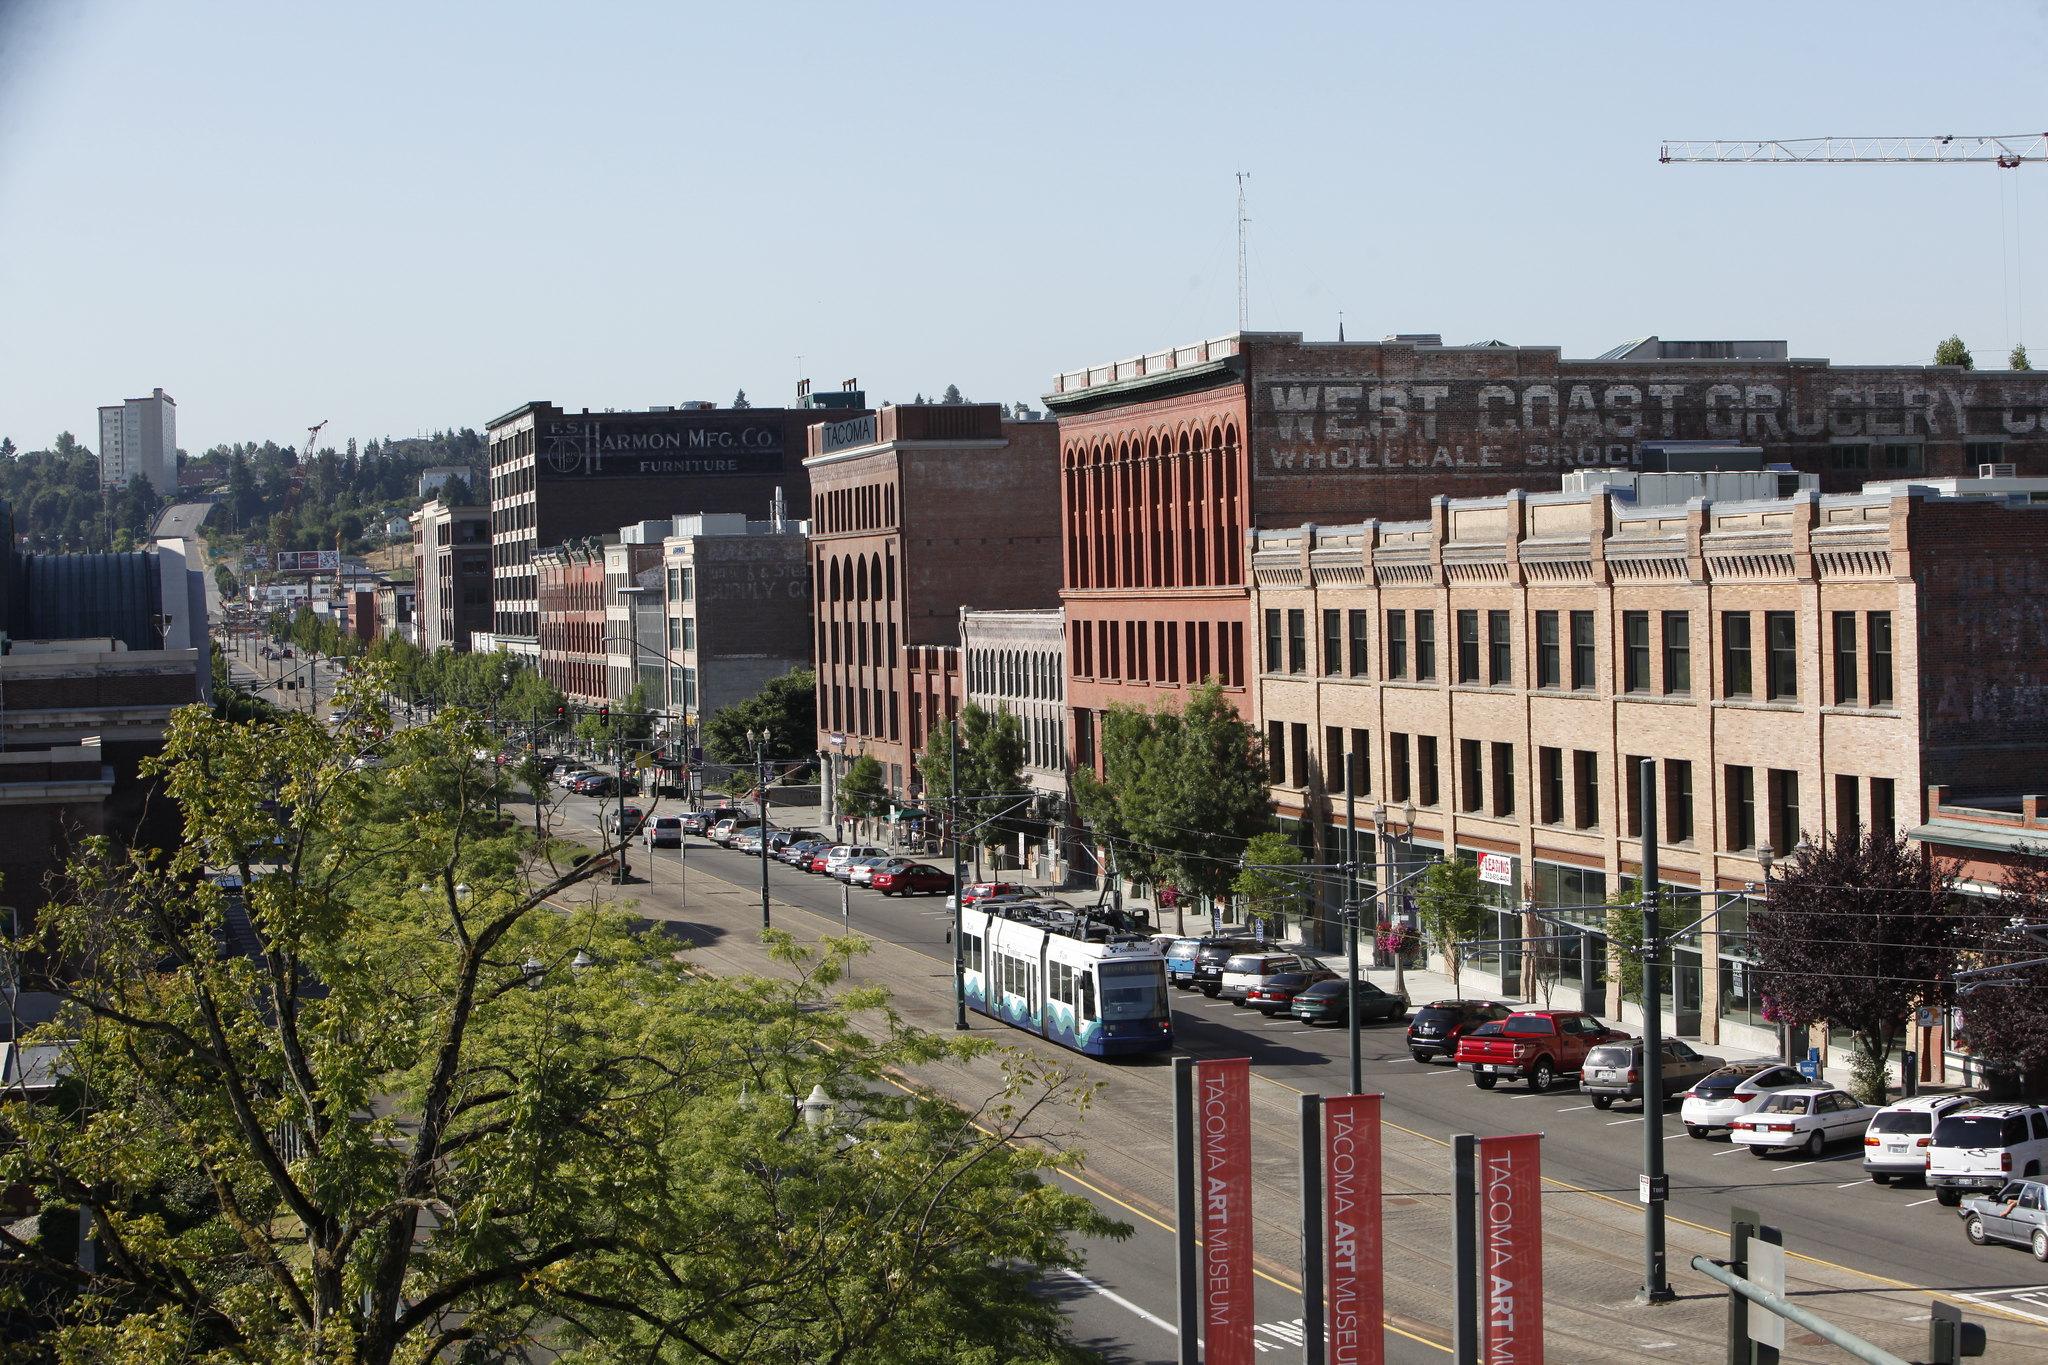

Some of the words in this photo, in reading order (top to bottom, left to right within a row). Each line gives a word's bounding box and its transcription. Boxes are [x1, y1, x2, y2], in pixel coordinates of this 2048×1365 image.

[825, 418, 871, 447] TACOMA
[1270, 384, 1449, 440] WEST
[1477, 384, 1685, 439] COAST
[1705, 383, 1978, 440] GROCERY
[2002, 383, 2048, 434] C
[639, 459, 738, 472] FURNITURE
[1270, 445, 1502, 469] WHOLESALE
[1204, 1072, 1227, 1172] TACOMA
[1331, 1106, 1355, 1215] TACOMA
[1207, 1176, 1228, 1224] ART
[1488, 1150, 1513, 1270] TACOMA
[1334, 1219, 1356, 1272] ART
[1208, 1228, 1230, 1326] MUSEUM
[1490, 1274, 1514, 1332] ART
[1336, 1277, 1358, 1365] MUSEU
